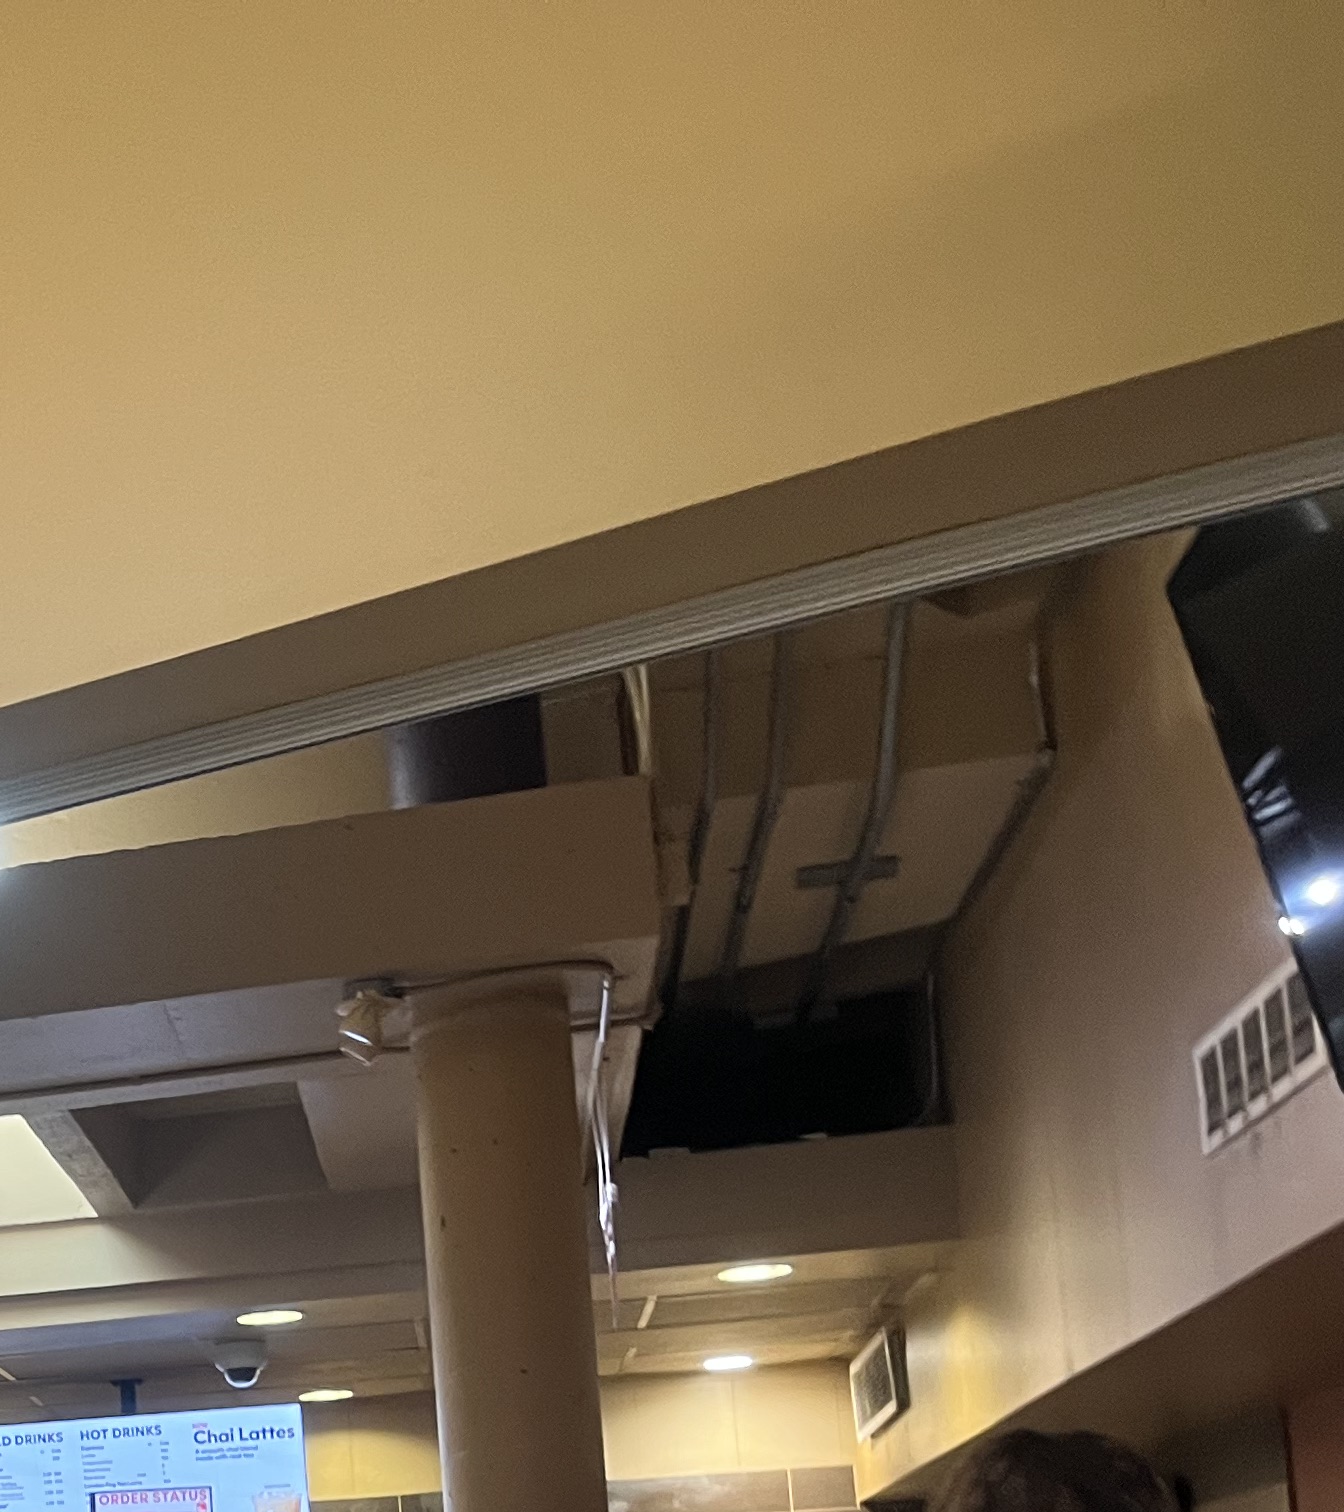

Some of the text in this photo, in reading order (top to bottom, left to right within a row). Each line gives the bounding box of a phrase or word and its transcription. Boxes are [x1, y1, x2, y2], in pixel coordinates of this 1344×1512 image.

[14, 1432, 64, 1446] DRINKS
[79, 1425, 163, 1442] HOT DRINKS
[193, 1426, 295, 1445] Chai Lattes
[99, 1489, 207, 1506] ORDER STATUS
